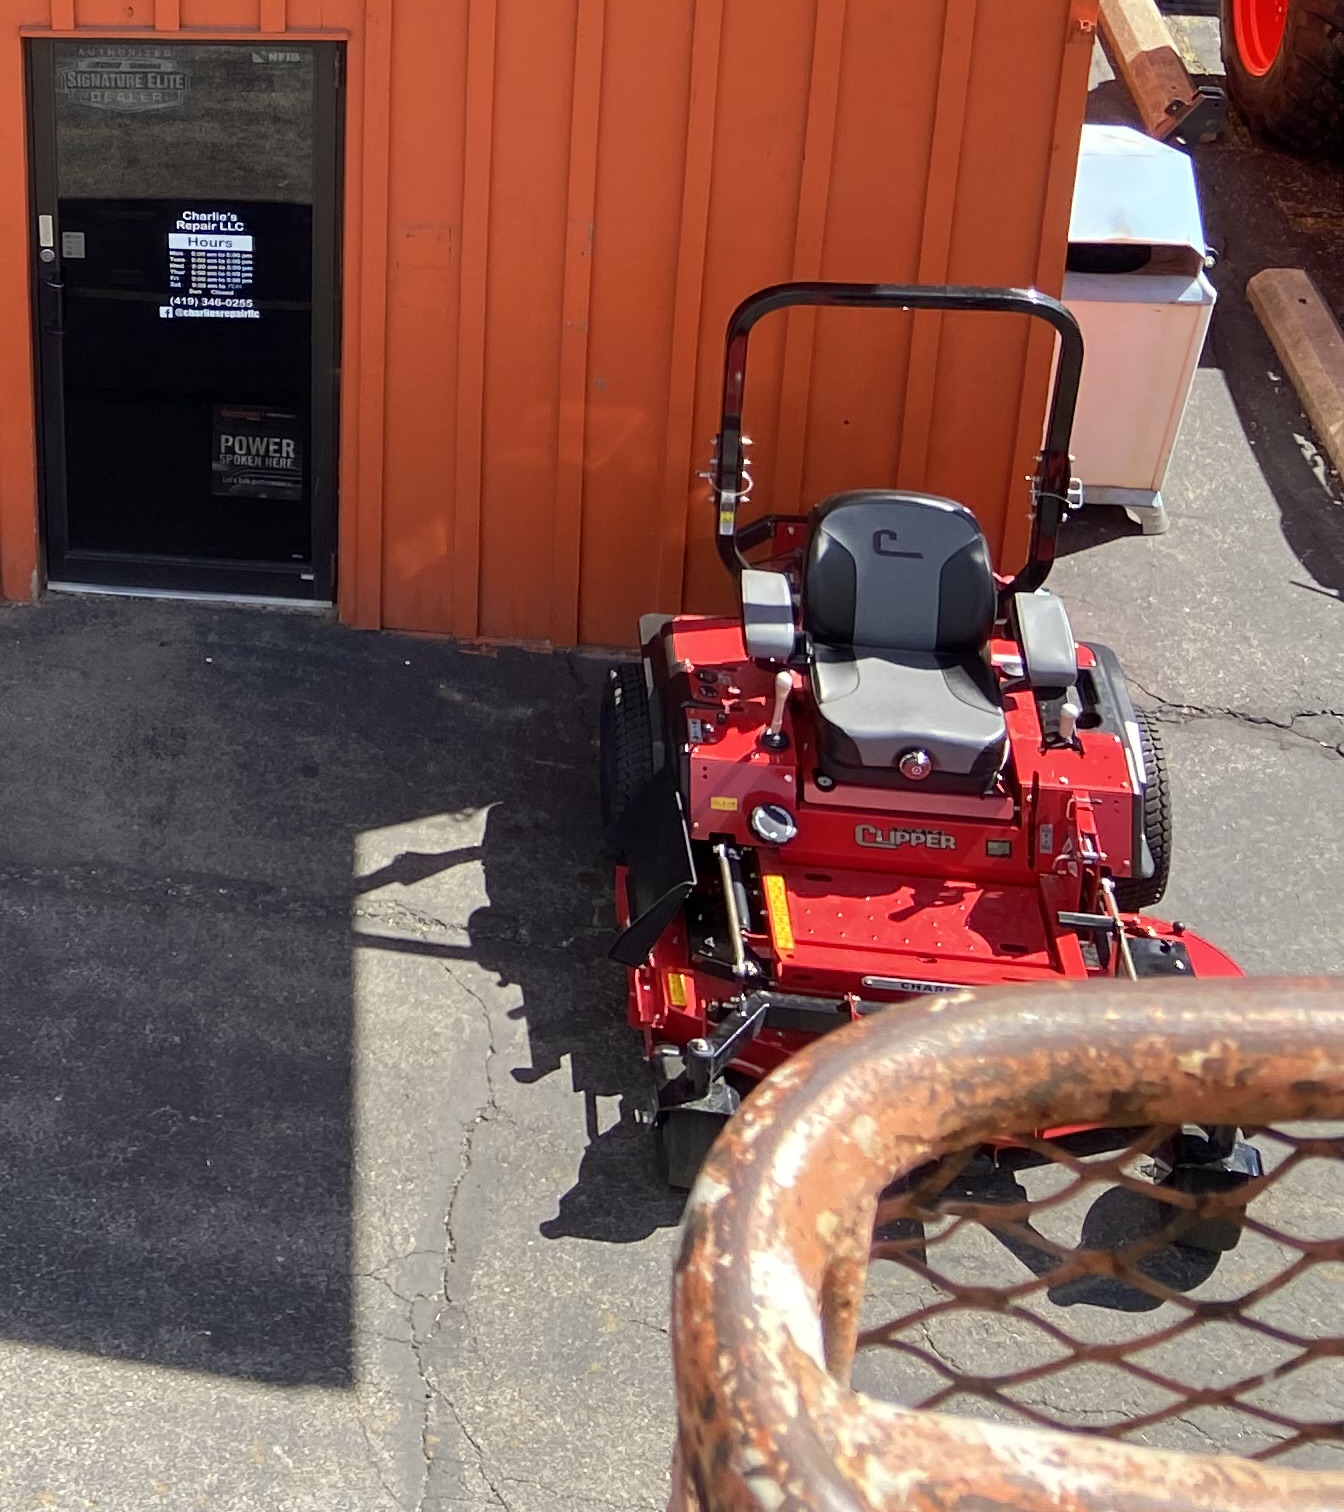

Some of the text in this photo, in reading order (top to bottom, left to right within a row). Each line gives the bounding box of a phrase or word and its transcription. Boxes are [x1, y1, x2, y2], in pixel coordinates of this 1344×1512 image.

[67, 71, 185, 89] SIGNATURE ELITE
[182, 210, 238, 221] Charlie's
[176, 220, 245, 232] Repair LLC
[188, 236, 233, 248] Hours
[220, 433, 295, 458] POWER
[219, 453, 262, 467] SPOKEN
[854, 823, 957, 849] CLIPPER
